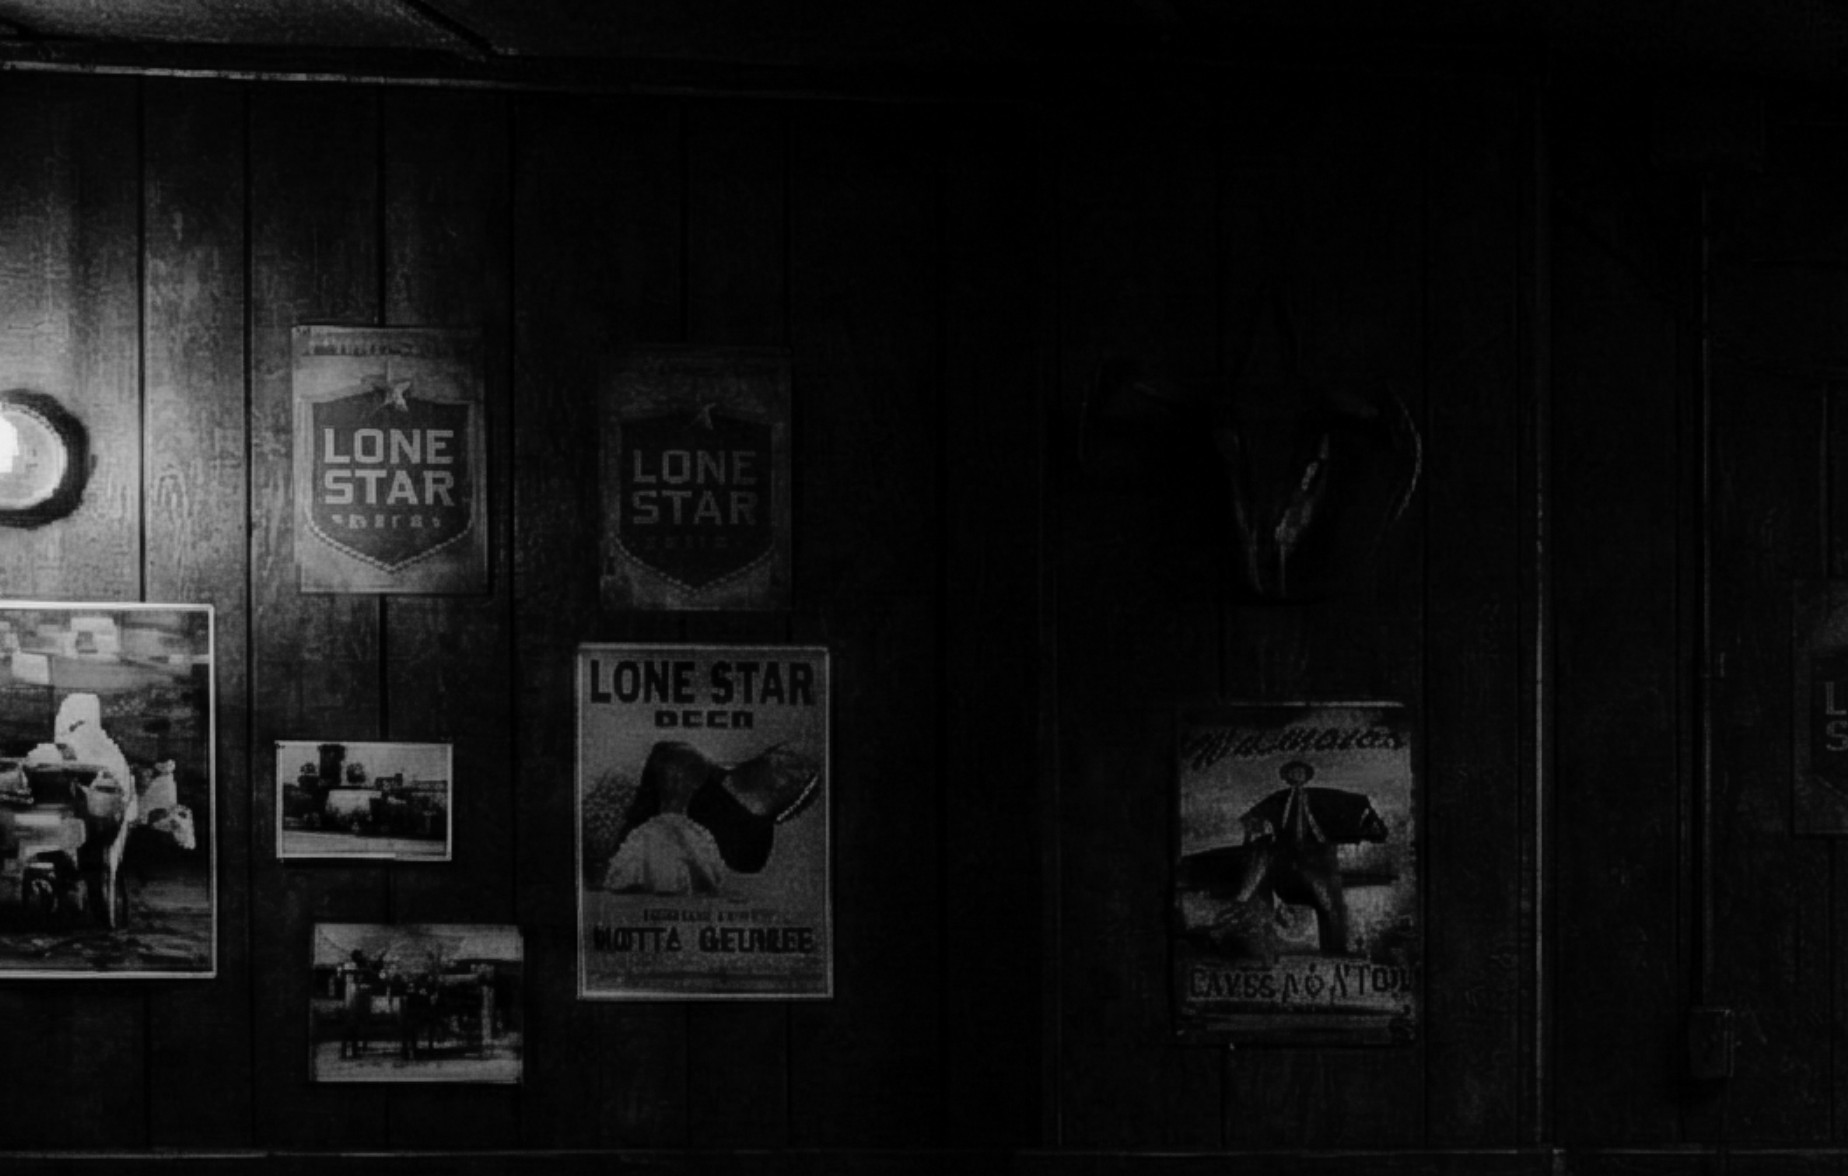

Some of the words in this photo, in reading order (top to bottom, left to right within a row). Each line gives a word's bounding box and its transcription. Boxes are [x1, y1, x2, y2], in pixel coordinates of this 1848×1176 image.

[323, 427, 456, 466] LONE
[632, 448, 759, 486] LONE
[324, 468, 456, 507] STAR
[630, 488, 759, 526] STAR
[590, 658, 697, 704] LONE
[709, 660, 816, 706] STAR
